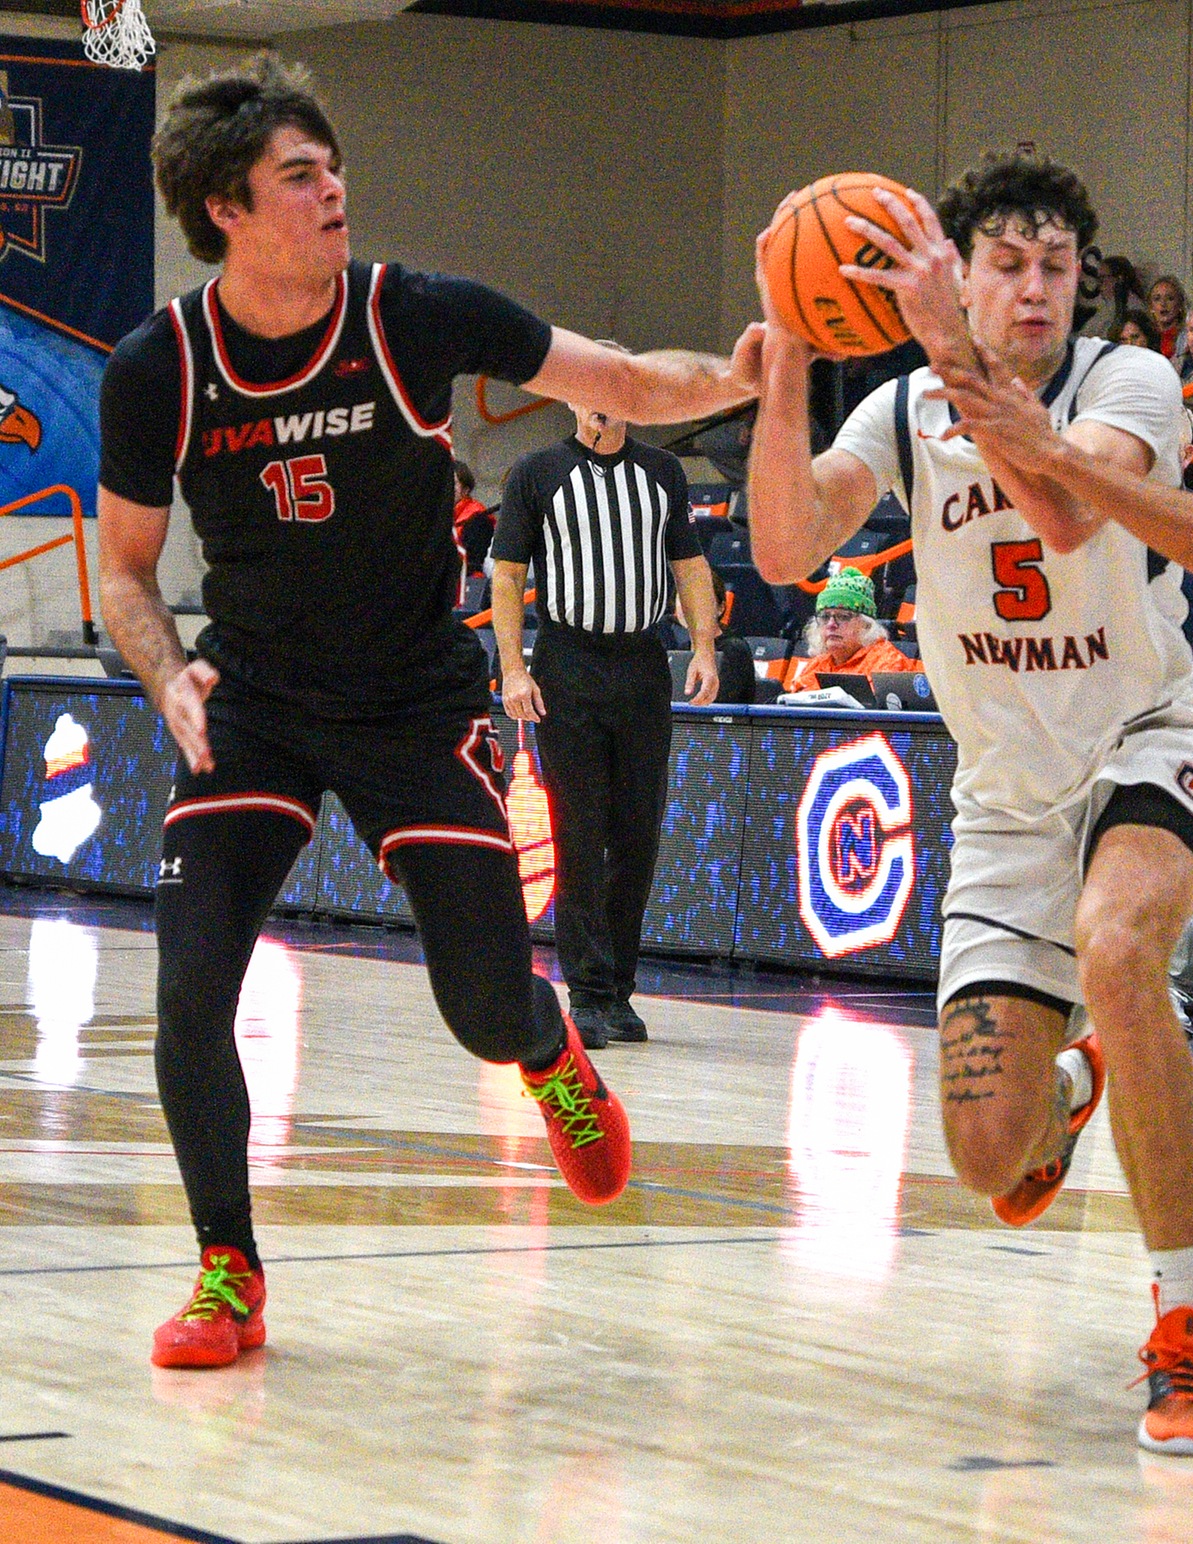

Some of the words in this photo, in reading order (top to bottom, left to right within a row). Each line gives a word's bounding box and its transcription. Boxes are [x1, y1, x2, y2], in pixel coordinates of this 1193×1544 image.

[0, 159, 64, 192] IGHT
[259, 453, 336, 523] 15
[990, 537, 1052, 622] 5
[957, 626, 1110, 673] NEWMAN
